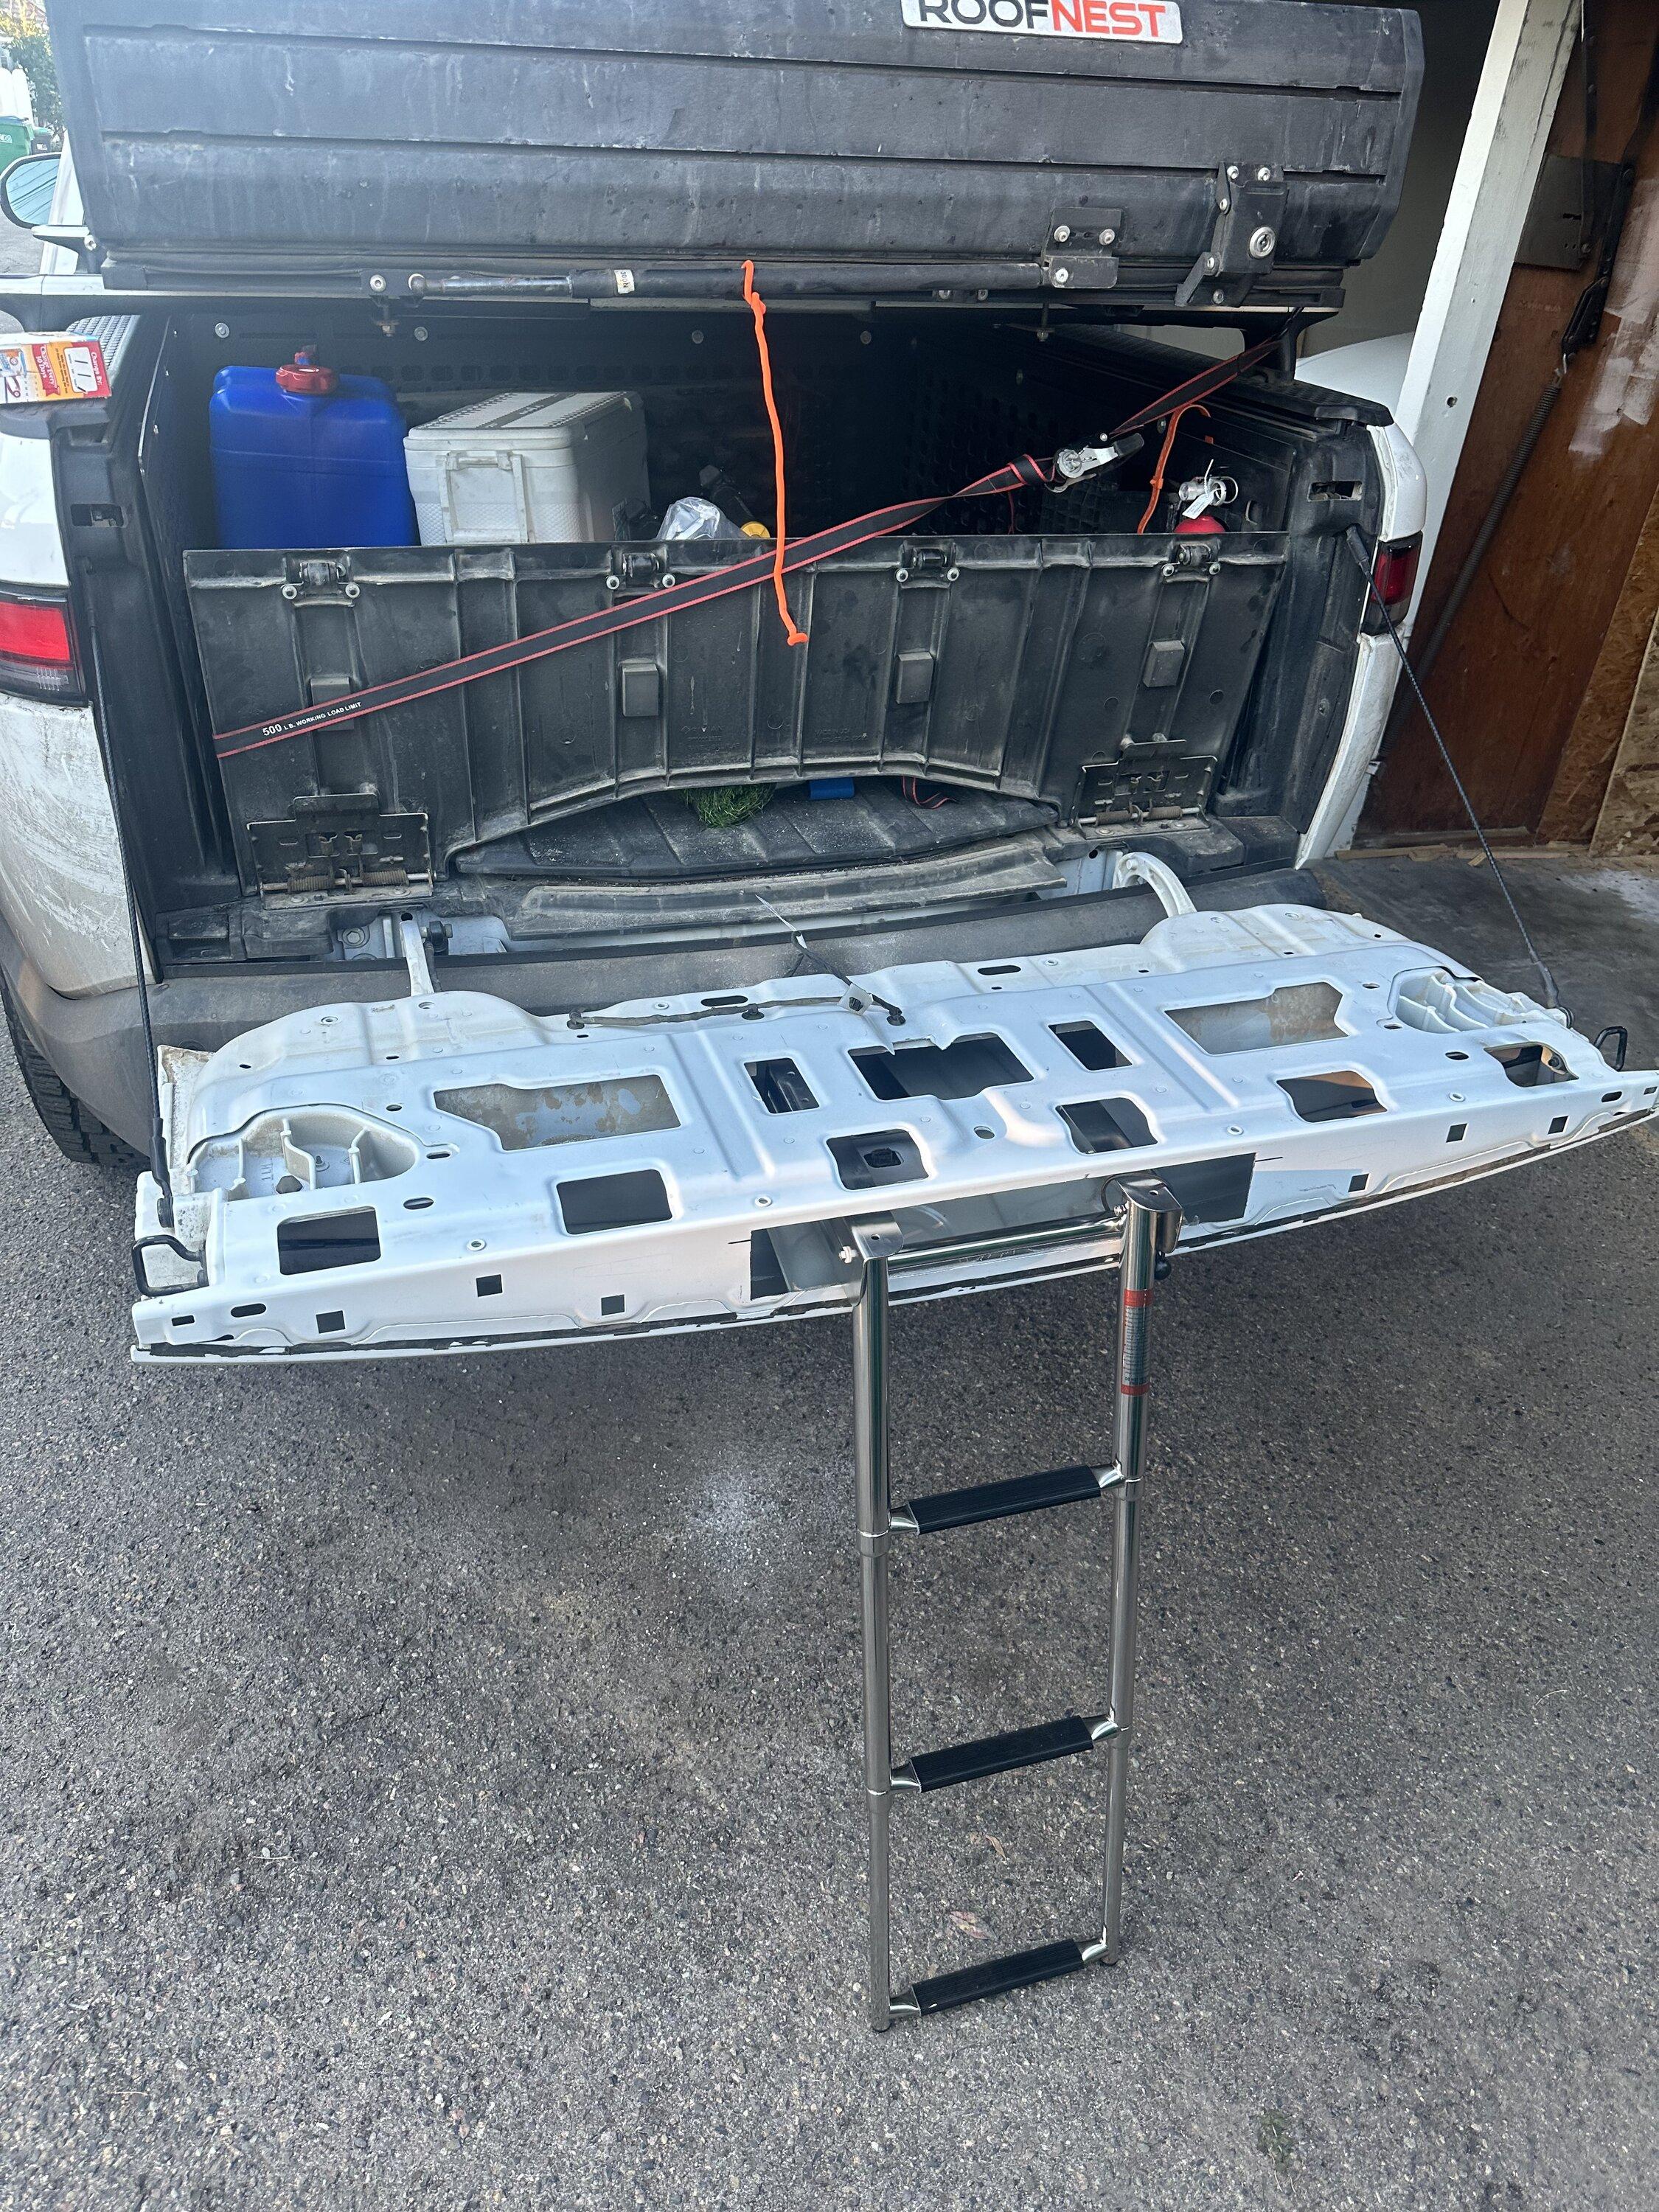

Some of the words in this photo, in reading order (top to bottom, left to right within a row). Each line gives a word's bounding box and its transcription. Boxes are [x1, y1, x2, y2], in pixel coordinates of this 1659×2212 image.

[919, 0, 1166, 37] ROOFNEST
[39, 364, 47, 378] Days
[41, 347, 50, 368] Change
[46, 369, 55, 385] Every
[91, 352, 100, 375] Change
[262, 723, 282, 736] 500
[296, 713, 326, 726] WORKING
[327, 707, 344, 717] LOAD
[344, 701, 361, 712] LIMIT
